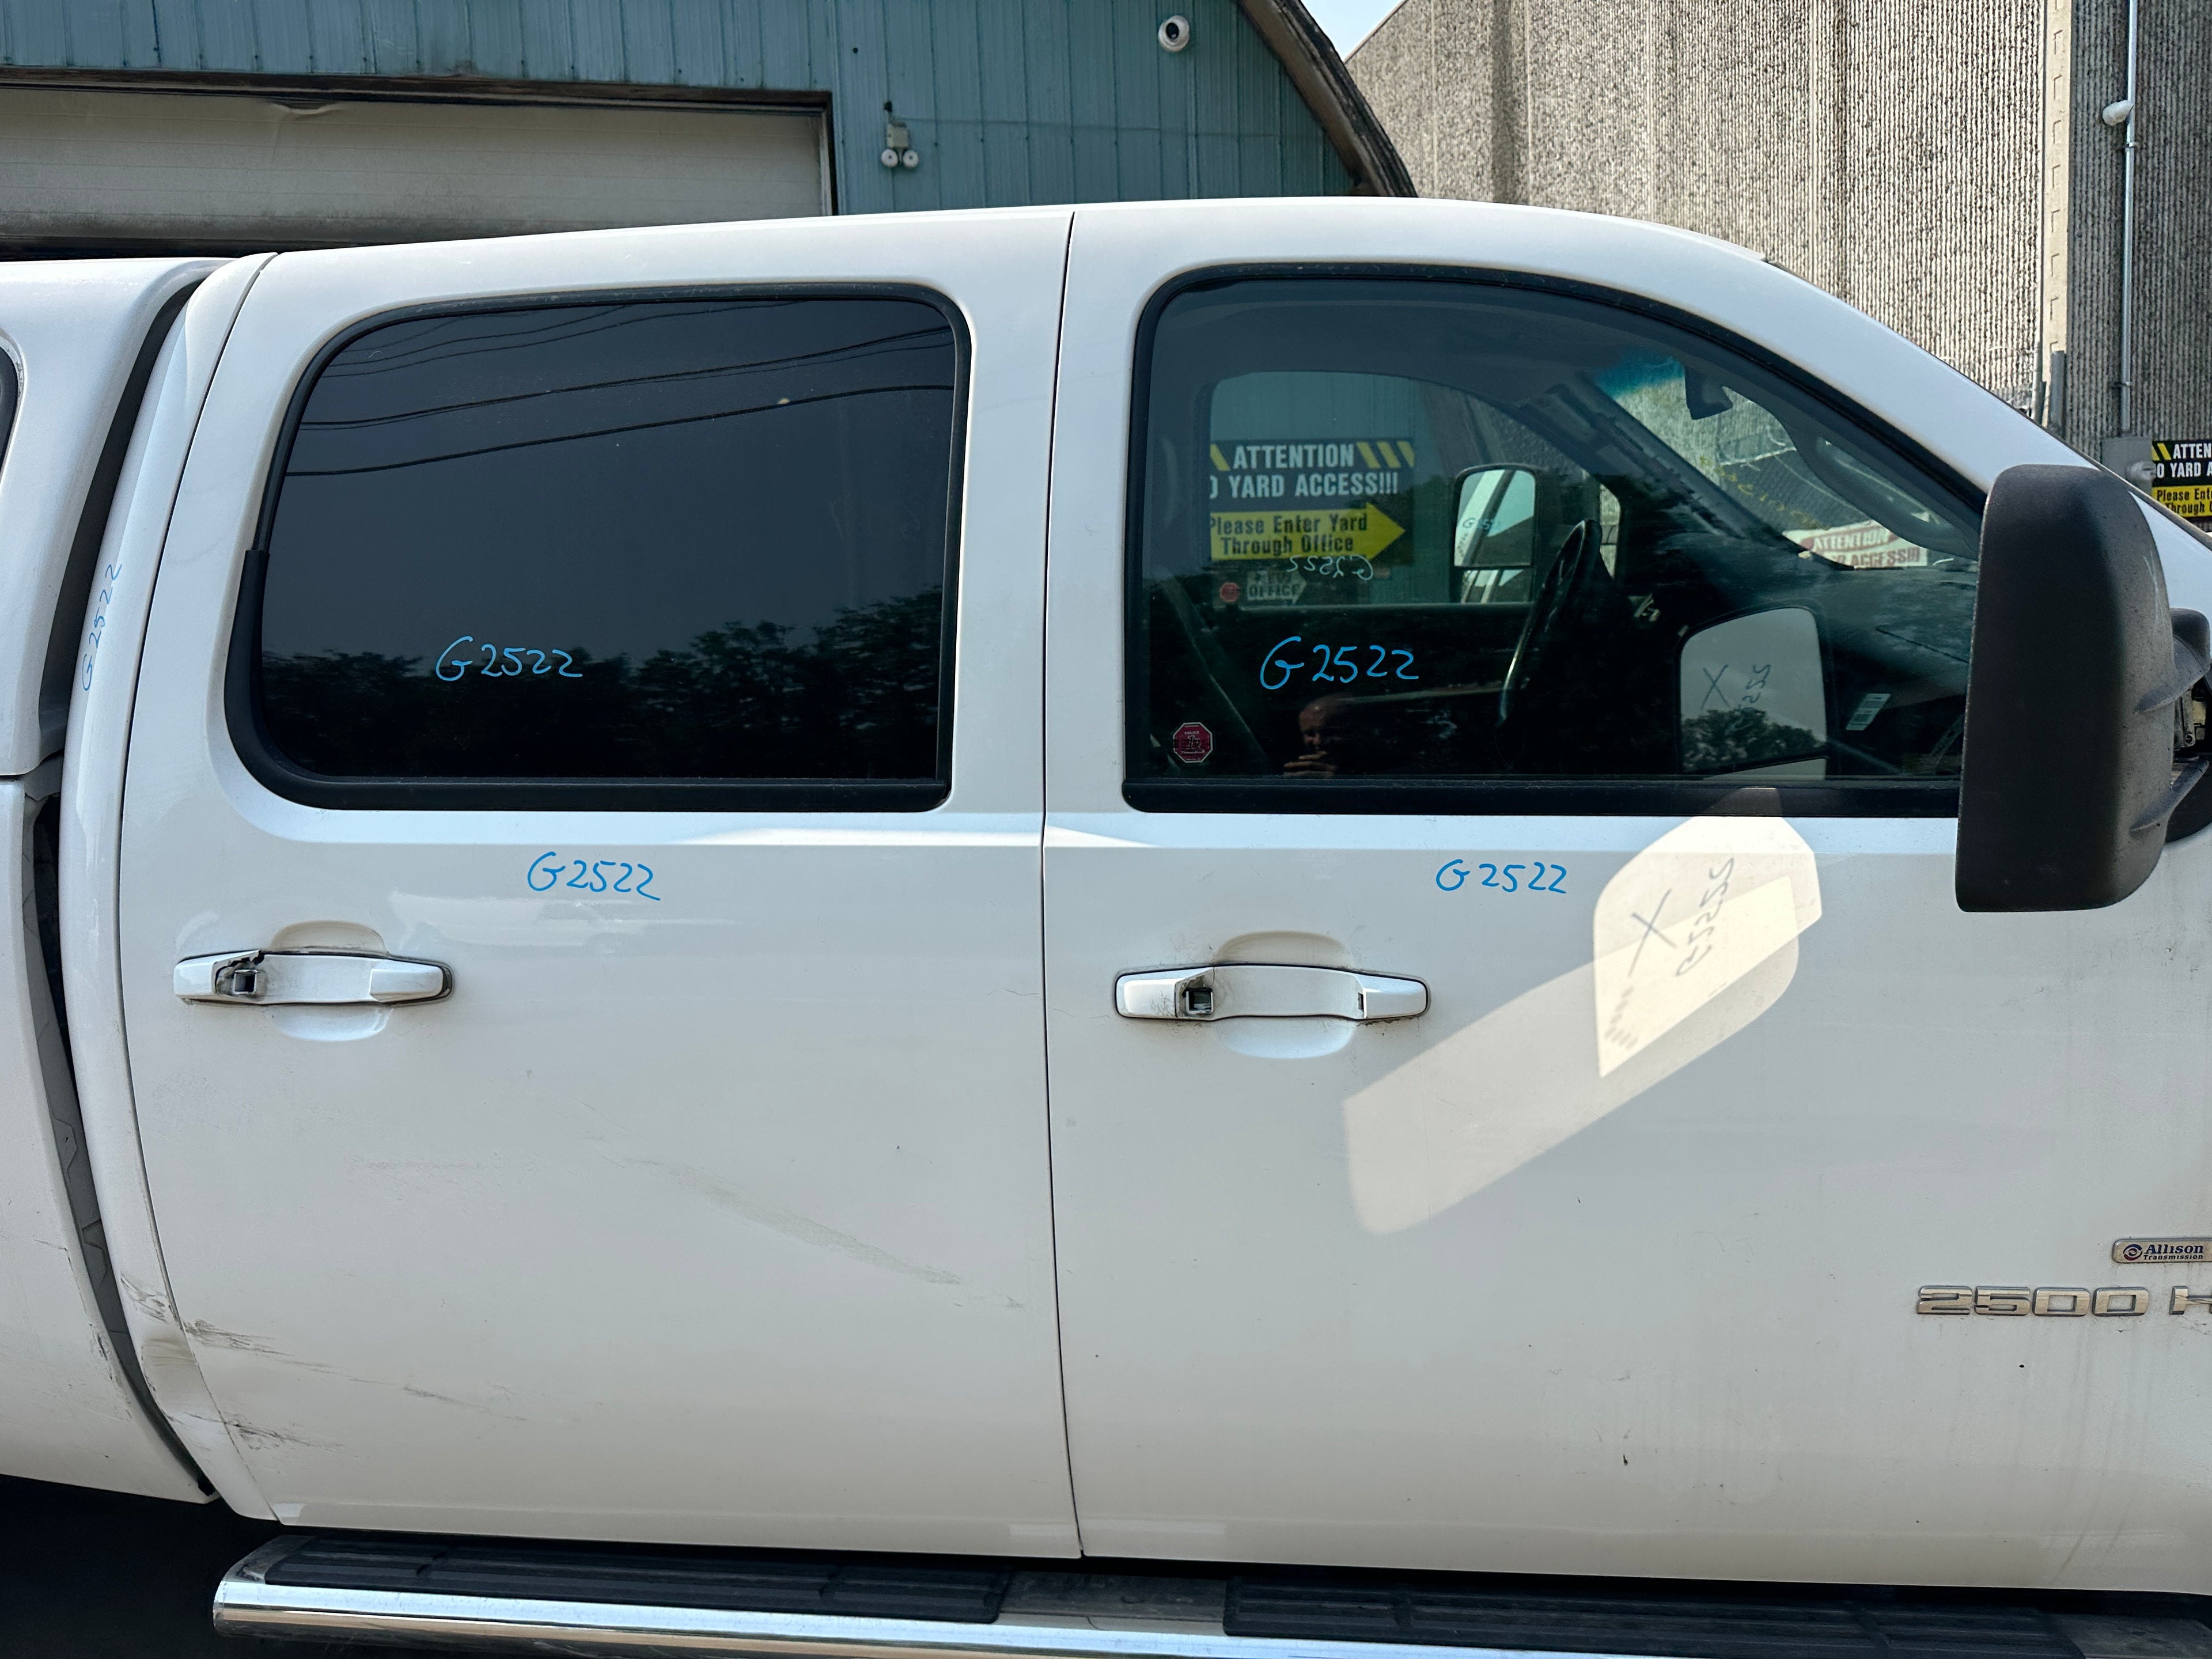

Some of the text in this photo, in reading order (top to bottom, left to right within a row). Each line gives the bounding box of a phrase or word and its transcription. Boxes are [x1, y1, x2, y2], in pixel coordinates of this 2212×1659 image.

[1233, 443, 1355, 469] ATTENTION
[2173, 442, 2212, 460] ATTEN
[2156, 462, 2165, 479] O
[2170, 461, 2202, 478] YARD
[1229, 473, 1285, 499] YARD
[1294, 471, 1399, 497] ACCESS!!!
[2157, 487, 2212, 501] Please Ent
[1210, 513, 1368, 535] Please Enter Yard
[1220, 536, 1354, 557] Through Office
[1813, 528, 1888, 551] ATTENTION
[82, 563, 123, 691] G2522
[435, 635, 583, 681] G2522
[1259, 635, 1419, 690] G2522
[527, 851, 661, 901] G2522
[1435, 858, 1567, 894] G2522
[2144, 1244, 2204, 1255] Allison
[1916, 1285, 2212, 1317] 2500 H
